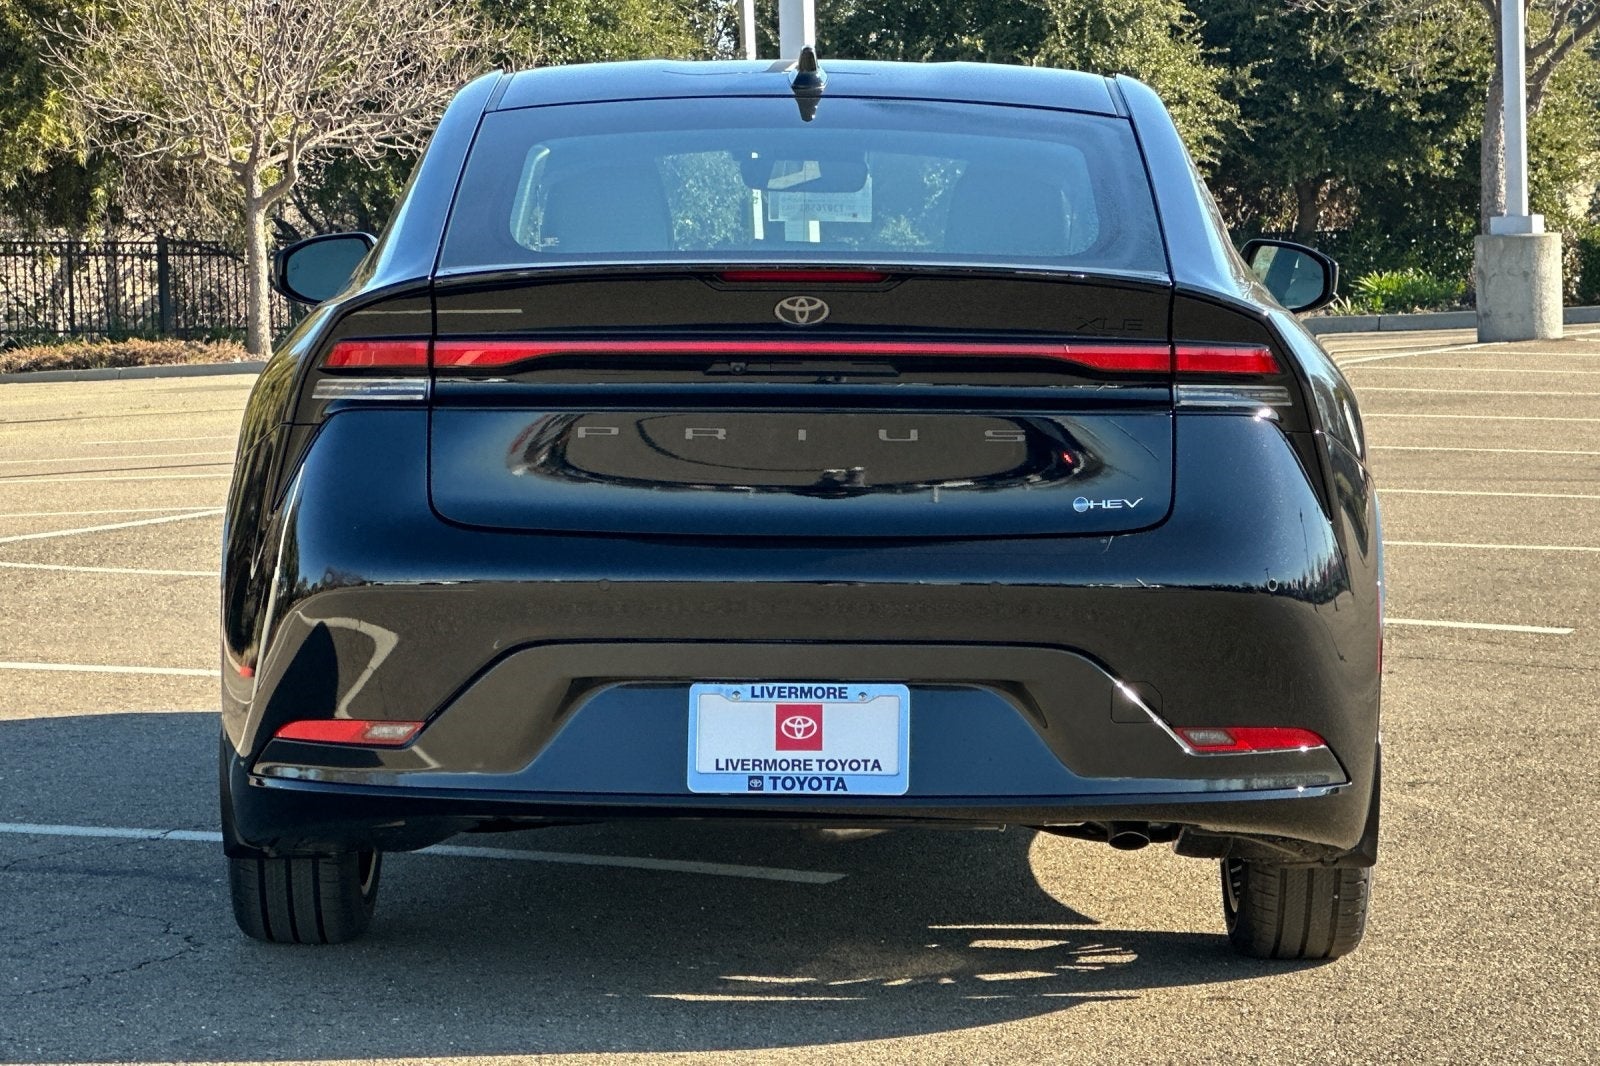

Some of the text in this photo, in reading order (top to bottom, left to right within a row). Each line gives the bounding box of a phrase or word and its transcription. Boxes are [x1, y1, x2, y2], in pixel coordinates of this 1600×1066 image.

[1076, 317, 1144, 331] XLE
[577, 426, 1026, 442] PRIUS
[1089, 497, 1144, 509] HEV
[750, 686, 848, 700] LIVERMORE
[715, 758, 882, 772] LIVERMORE TOYOTA
[768, 776, 848, 791] TOYOTA
